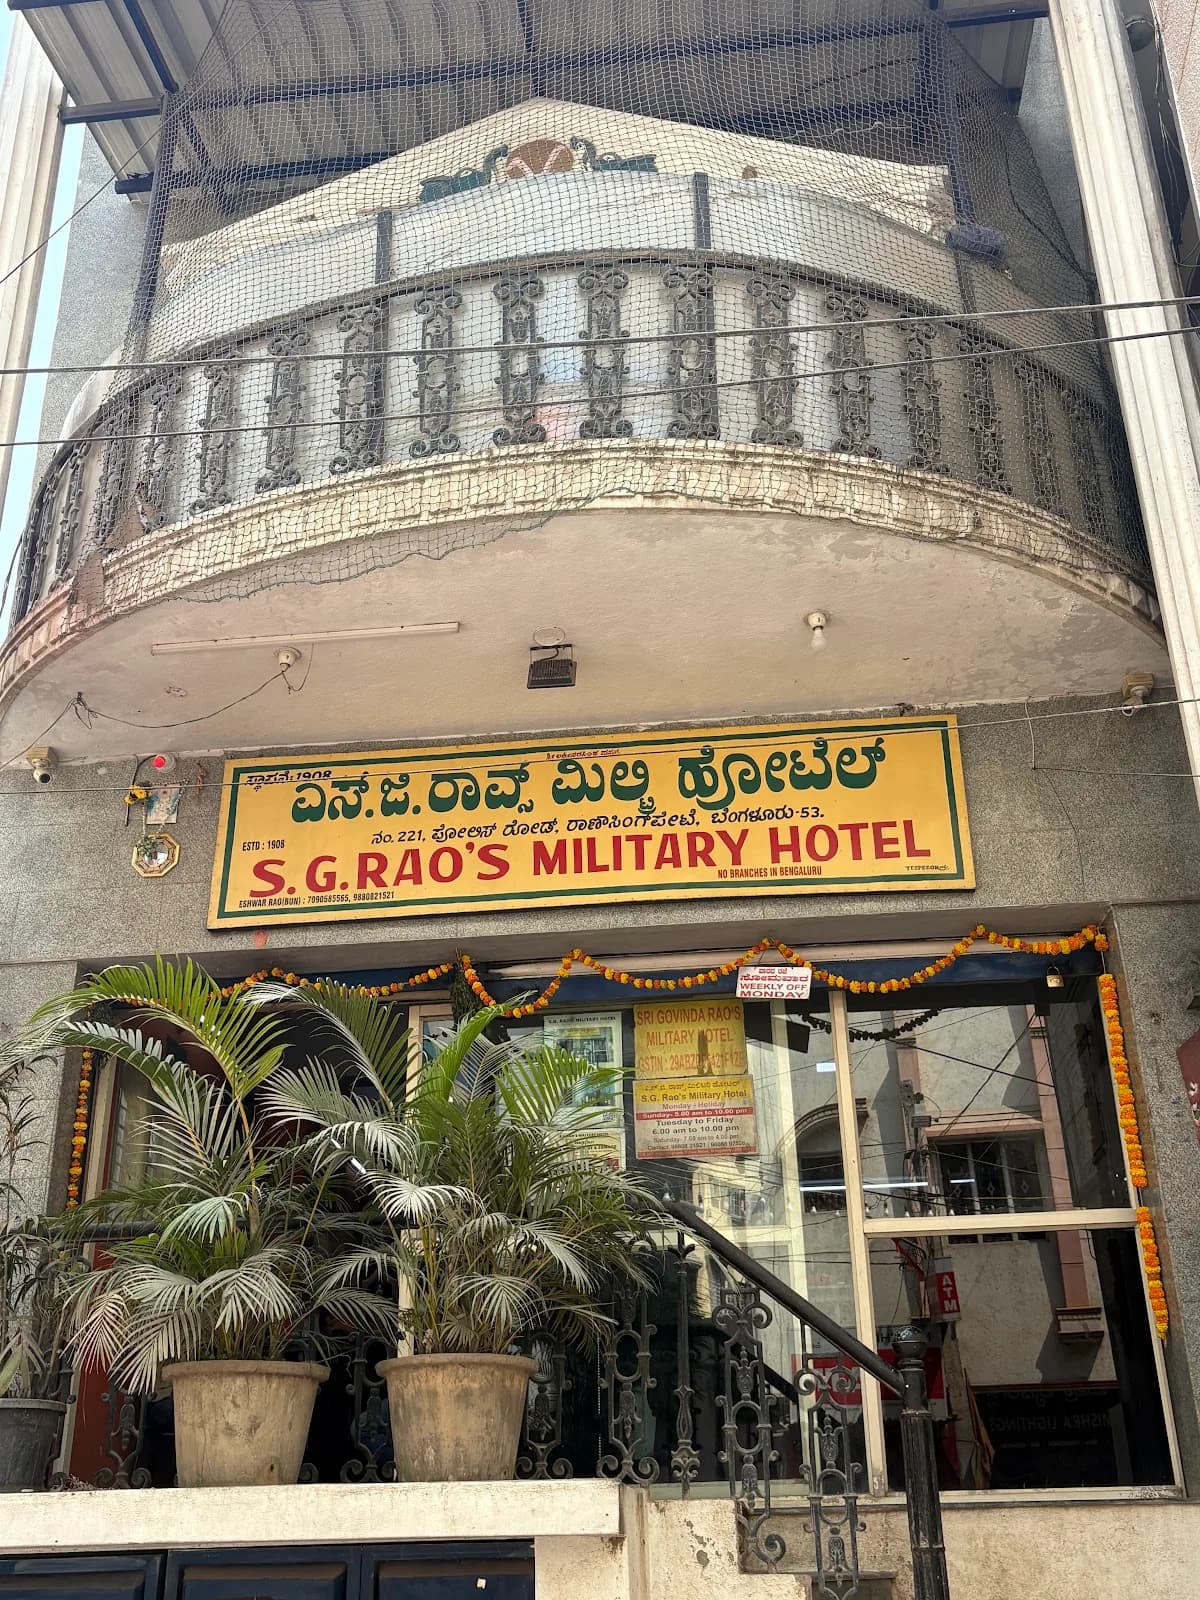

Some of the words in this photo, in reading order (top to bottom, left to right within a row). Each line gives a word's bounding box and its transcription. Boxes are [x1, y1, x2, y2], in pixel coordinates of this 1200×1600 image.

[296, 770, 332, 781] 1908
[678, 737, 886, 811] ಹೋಟೆಲ್
[242, 841, 260, 851] ESTD
[267, 840, 285, 850] 1908
[533, 829, 751, 876] MILITARY
[769, 818, 931, 865] HOTEL
[718, 869, 728, 879] NO
[730, 867, 768, 878] BRANCHES
[770, 866, 778, 876] IN
[780, 865, 822, 876] BENGALURU
[238, 898, 266, 908] ESHWAR
[656, 1007, 706, 1024] GOVINDA
[708, 1006, 741, 1020] RAO'S
[646, 1029, 696, 1047] MILITARY
[662, 1092, 687, 1102] Rao's
[688, 1090, 721, 1100] Military
[724, 1090, 747, 1098] Hotel
[662, 1102, 690, 1110] Monday
[698, 1100, 726, 1108] Holiday
[656, 1118, 692, 1126] Tuesday
